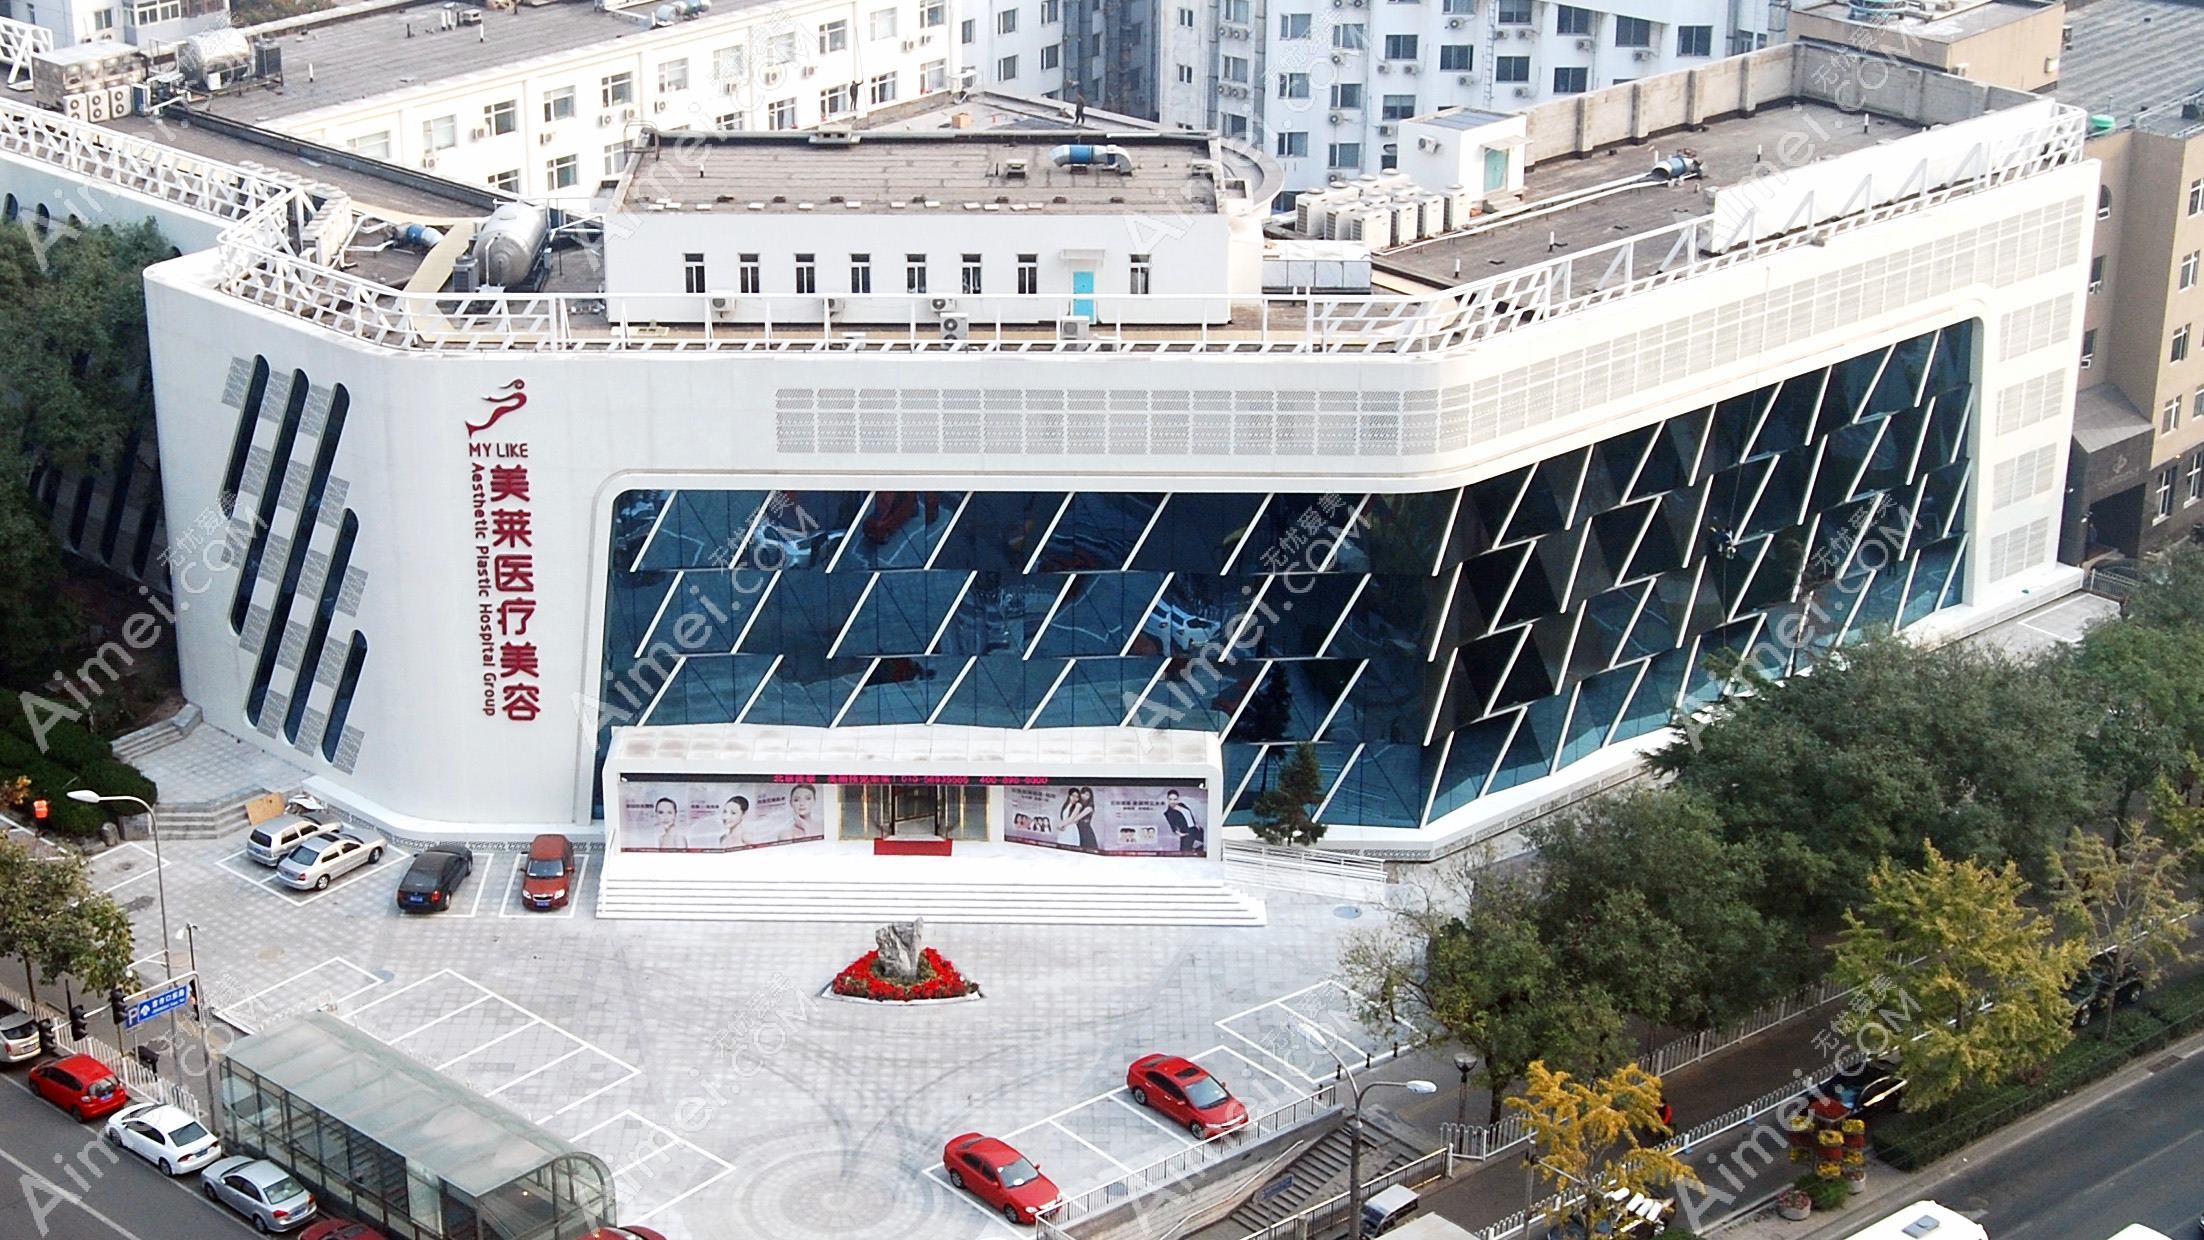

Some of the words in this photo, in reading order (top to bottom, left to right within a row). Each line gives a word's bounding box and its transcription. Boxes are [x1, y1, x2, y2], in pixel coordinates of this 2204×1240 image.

[469, 443, 491, 457] MY
[497, 443, 528, 457] LIKE
[471, 462, 488, 539] Aesthetic
[476, 546, 491, 597] Plastic
[490, 464, 541, 721] 美莱医疗美容
[479, 604, 496, 666] Hospital
[482, 672, 497, 717] Group
